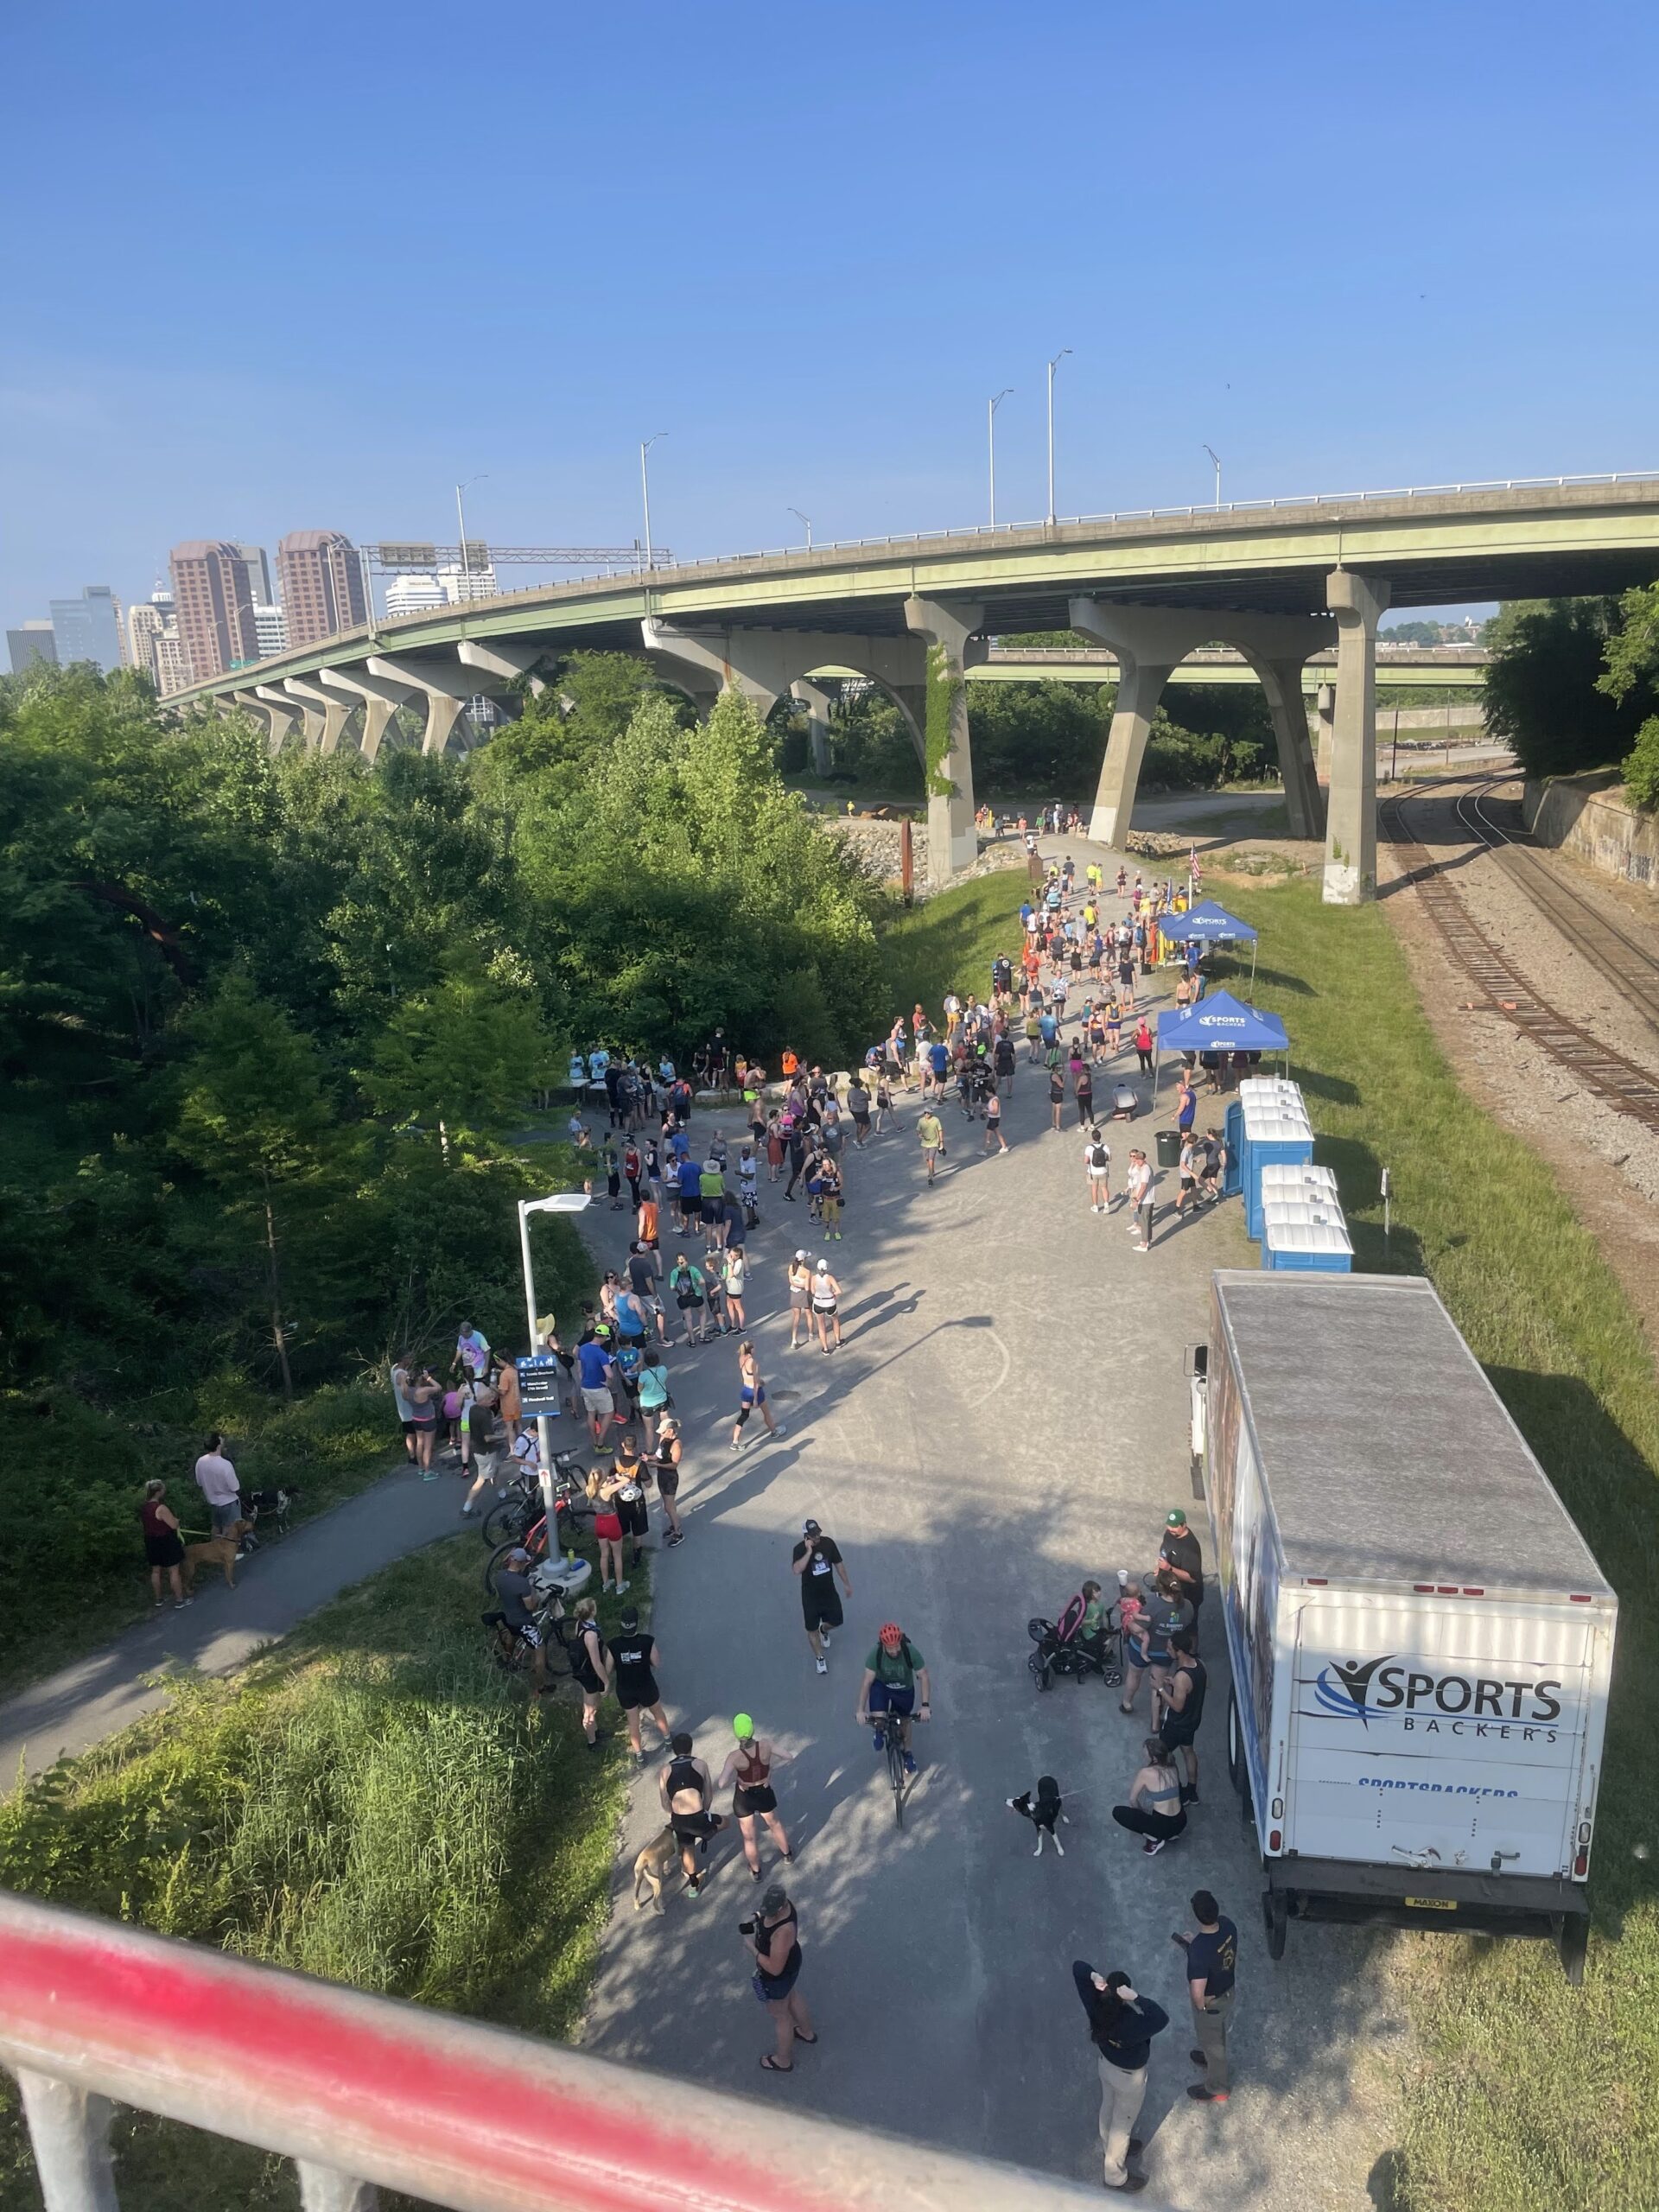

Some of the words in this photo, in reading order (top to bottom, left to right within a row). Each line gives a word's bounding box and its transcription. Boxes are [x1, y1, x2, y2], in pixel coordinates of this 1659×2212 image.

[1376, 1667, 1561, 1720] SPORTS
[1404, 1718, 1556, 1743] BACKERS
[1414, 1898, 1449, 1908] MAXON
